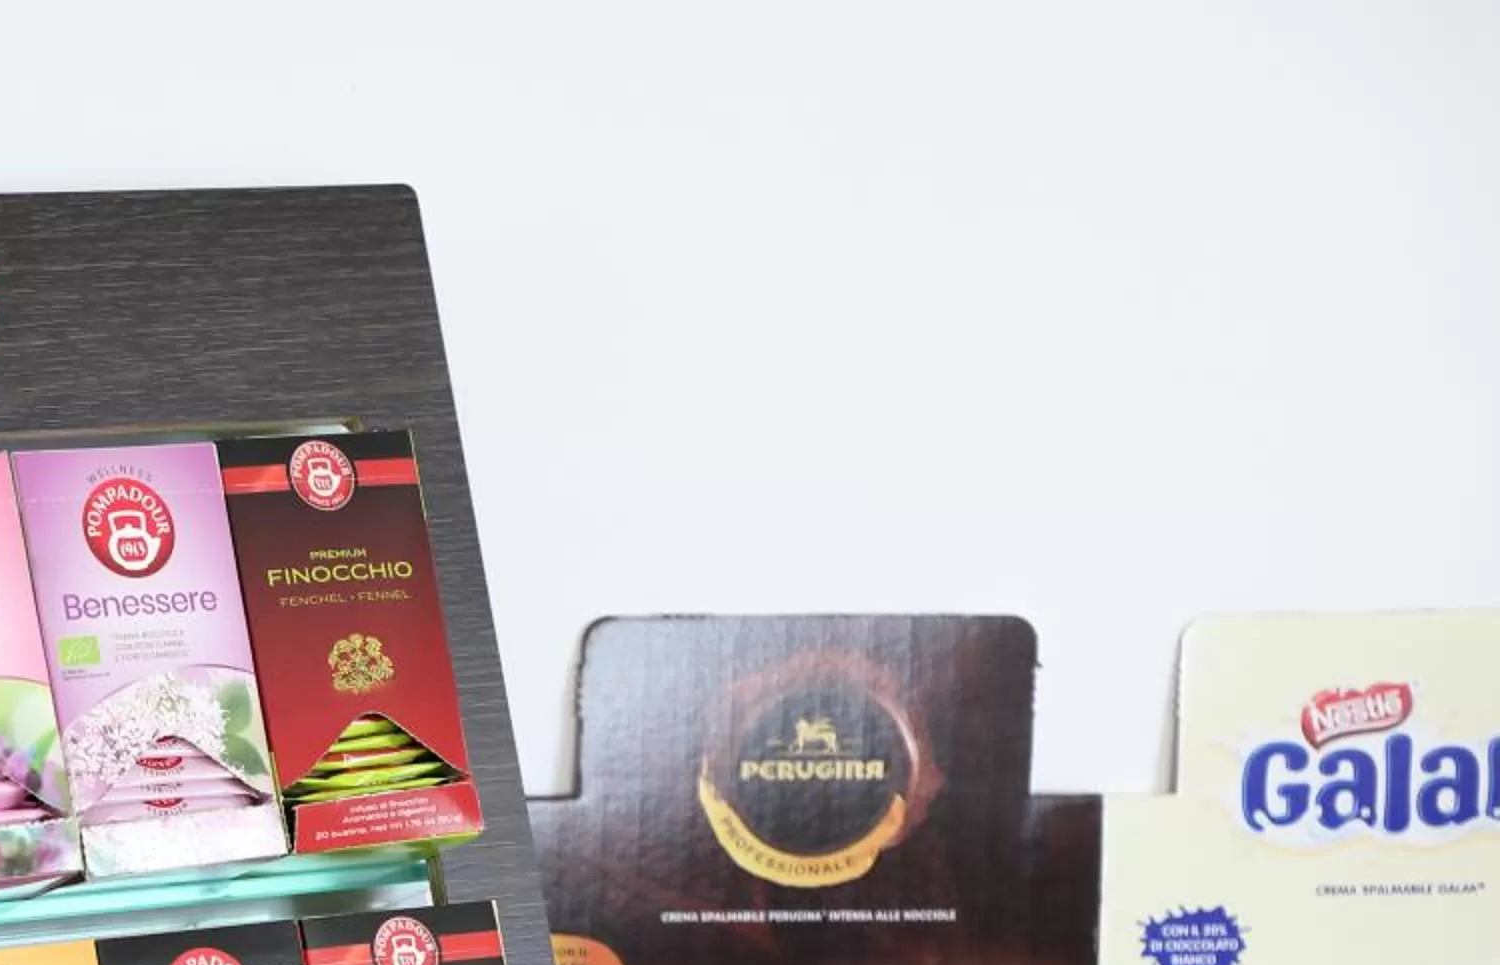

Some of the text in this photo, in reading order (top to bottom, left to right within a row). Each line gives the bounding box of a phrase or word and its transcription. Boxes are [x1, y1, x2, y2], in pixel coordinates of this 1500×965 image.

[88, 485, 170, 538] POMPADOUR
[267, 561, 413, 587] FINOCCHIO
[62, 590, 218, 621] Benessere
[740, 759, 885, 781] PERUGINA
[722, 816, 853, 876] PROFESSIONALE
